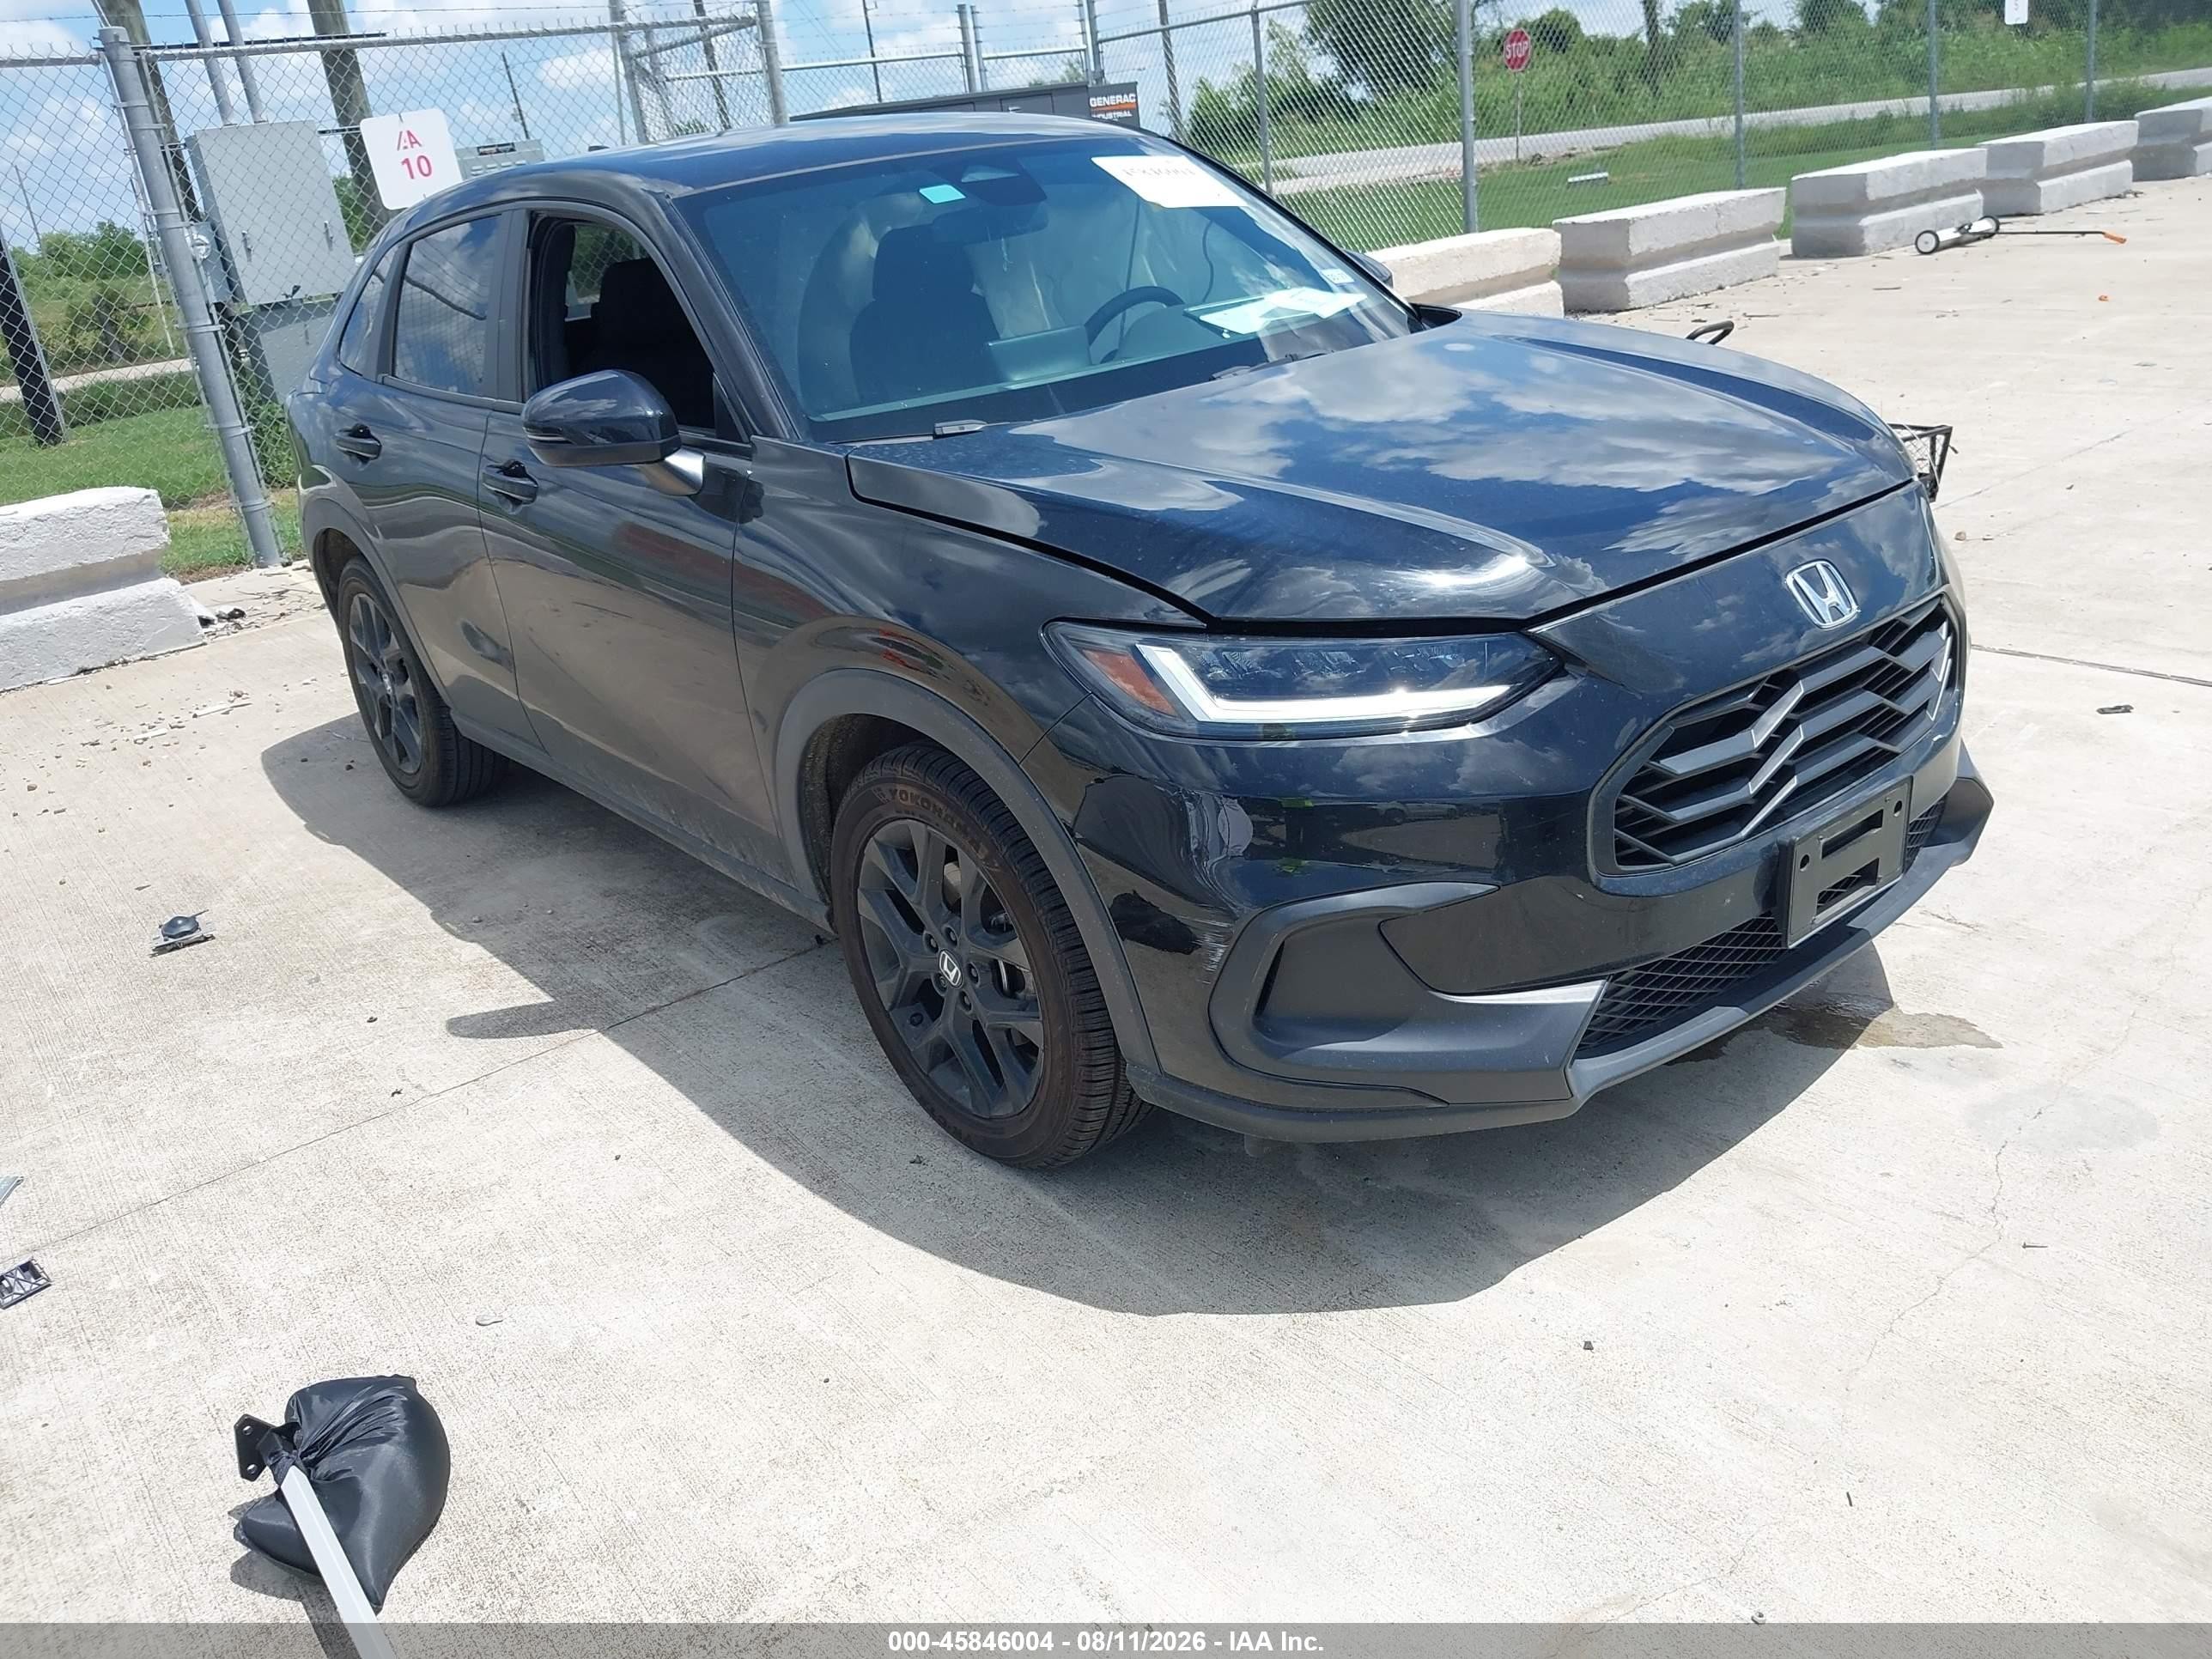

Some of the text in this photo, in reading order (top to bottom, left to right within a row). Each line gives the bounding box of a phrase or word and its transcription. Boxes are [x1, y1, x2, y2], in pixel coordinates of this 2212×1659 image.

[1506, 41, 1528, 59] STOP
[1089, 94, 1136, 107] GENERAC
[401, 155, 433, 179] 10
